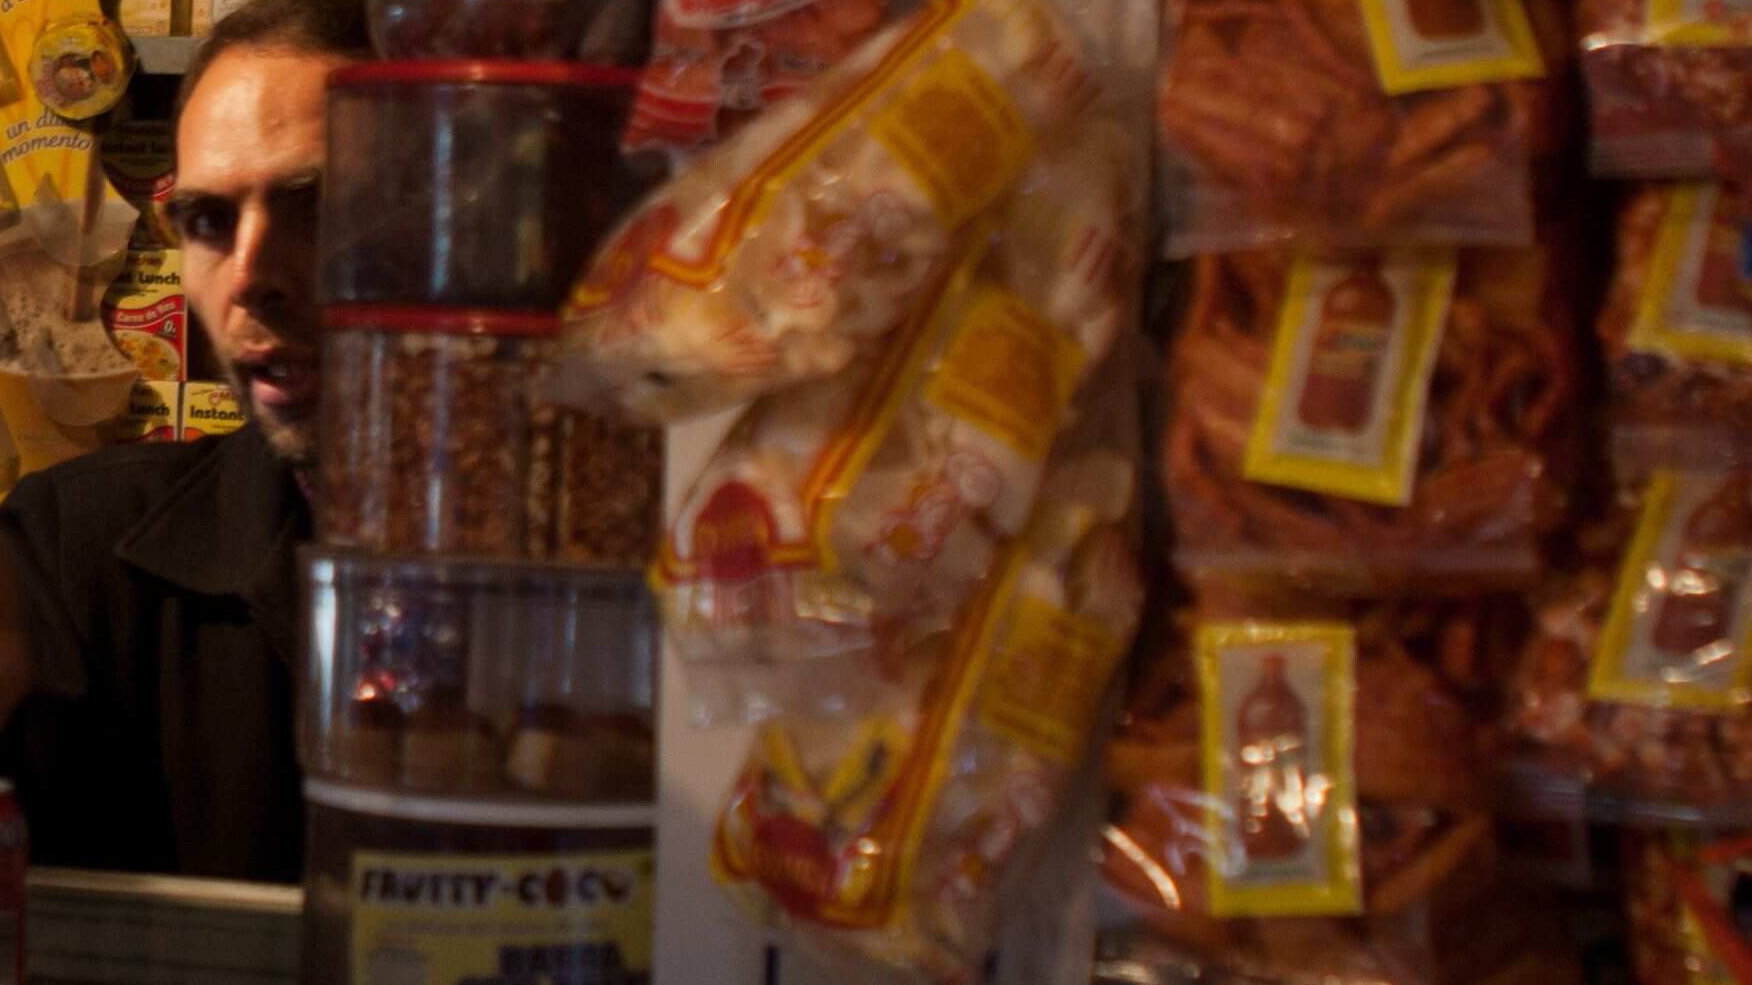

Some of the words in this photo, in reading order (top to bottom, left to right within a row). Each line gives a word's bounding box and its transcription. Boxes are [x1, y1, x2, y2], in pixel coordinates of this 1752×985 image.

[5, 118, 31, 141] un
[0, 133, 92, 164] momento
[138, 270, 181, 286] Lunch
